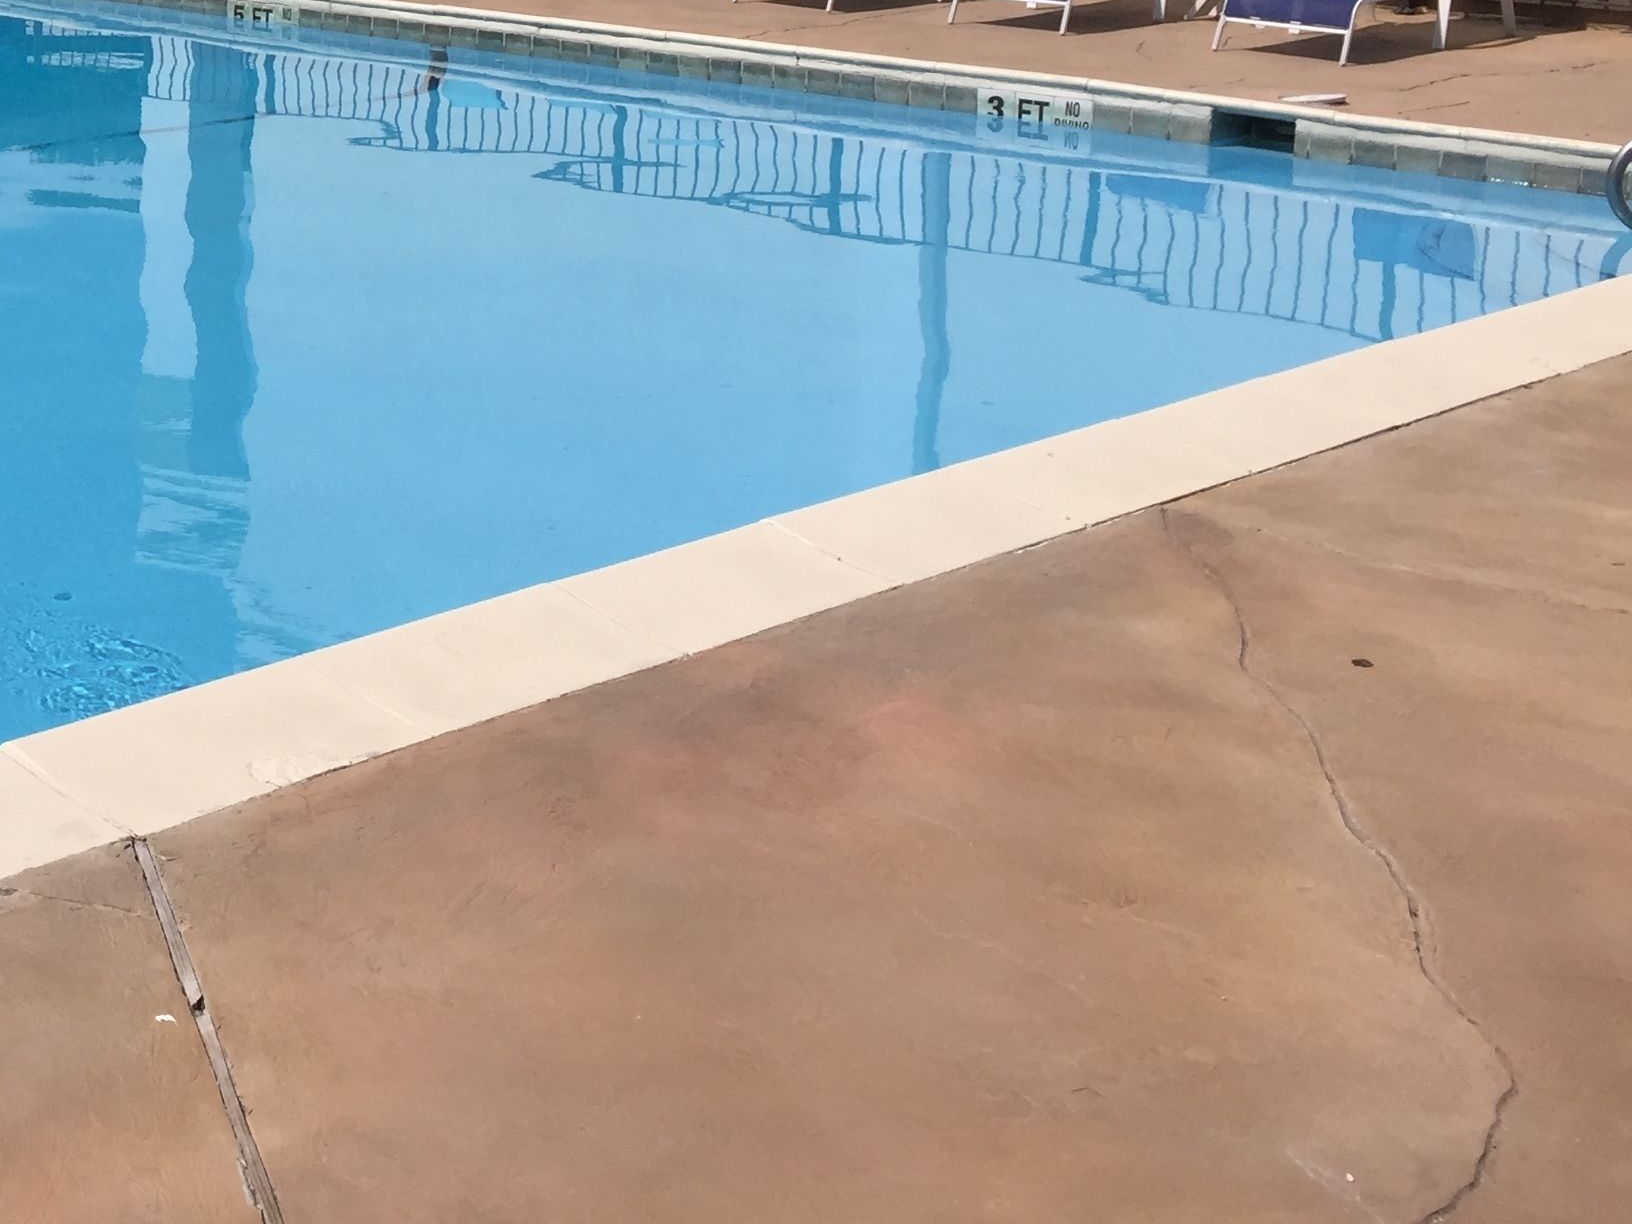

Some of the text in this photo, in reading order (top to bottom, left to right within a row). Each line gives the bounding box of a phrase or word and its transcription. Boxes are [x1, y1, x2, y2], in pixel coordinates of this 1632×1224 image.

[234, 5, 245, 20] 5
[252, 7, 273, 23] FT
[987, 95, 1050, 122] 3 FT
[1065, 101, 1081, 118] NO
